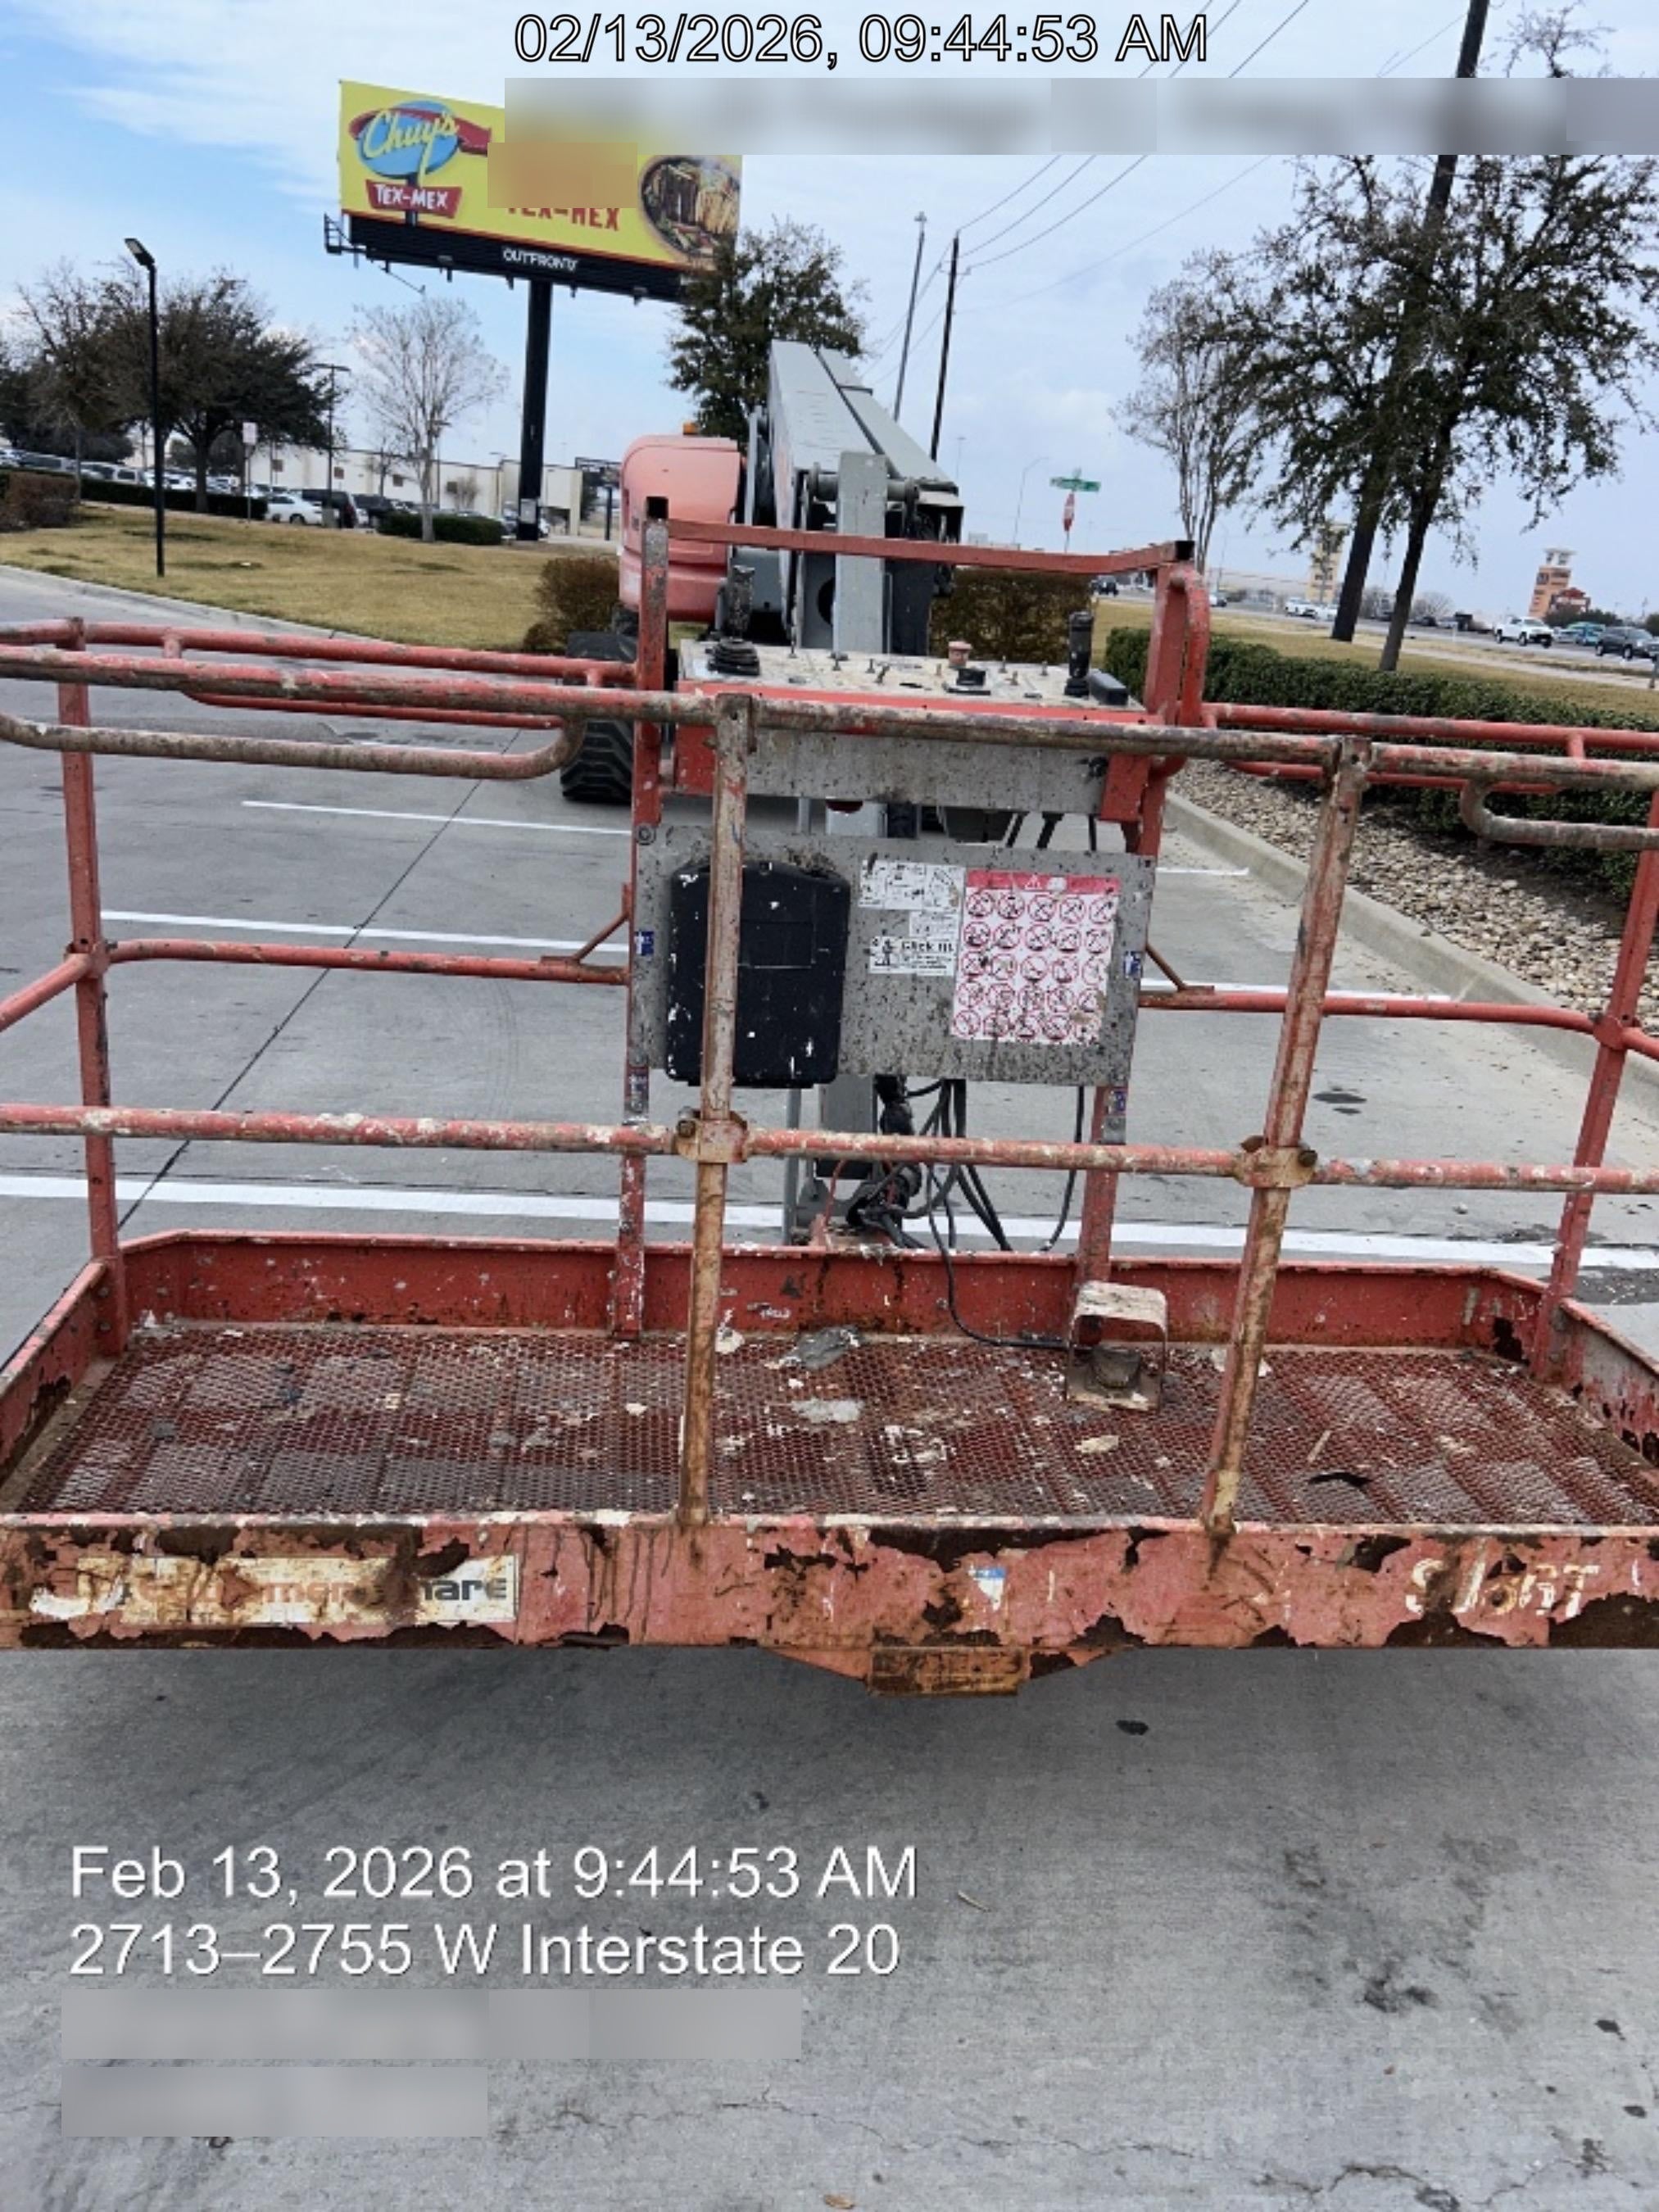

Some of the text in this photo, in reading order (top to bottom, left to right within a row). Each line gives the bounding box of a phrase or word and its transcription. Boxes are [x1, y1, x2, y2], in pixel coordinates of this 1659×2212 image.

[363, 111, 460, 187] Chuy's
[374, 184, 448, 210] TEX-MEX
[508, 207, 620, 231] -MEX
